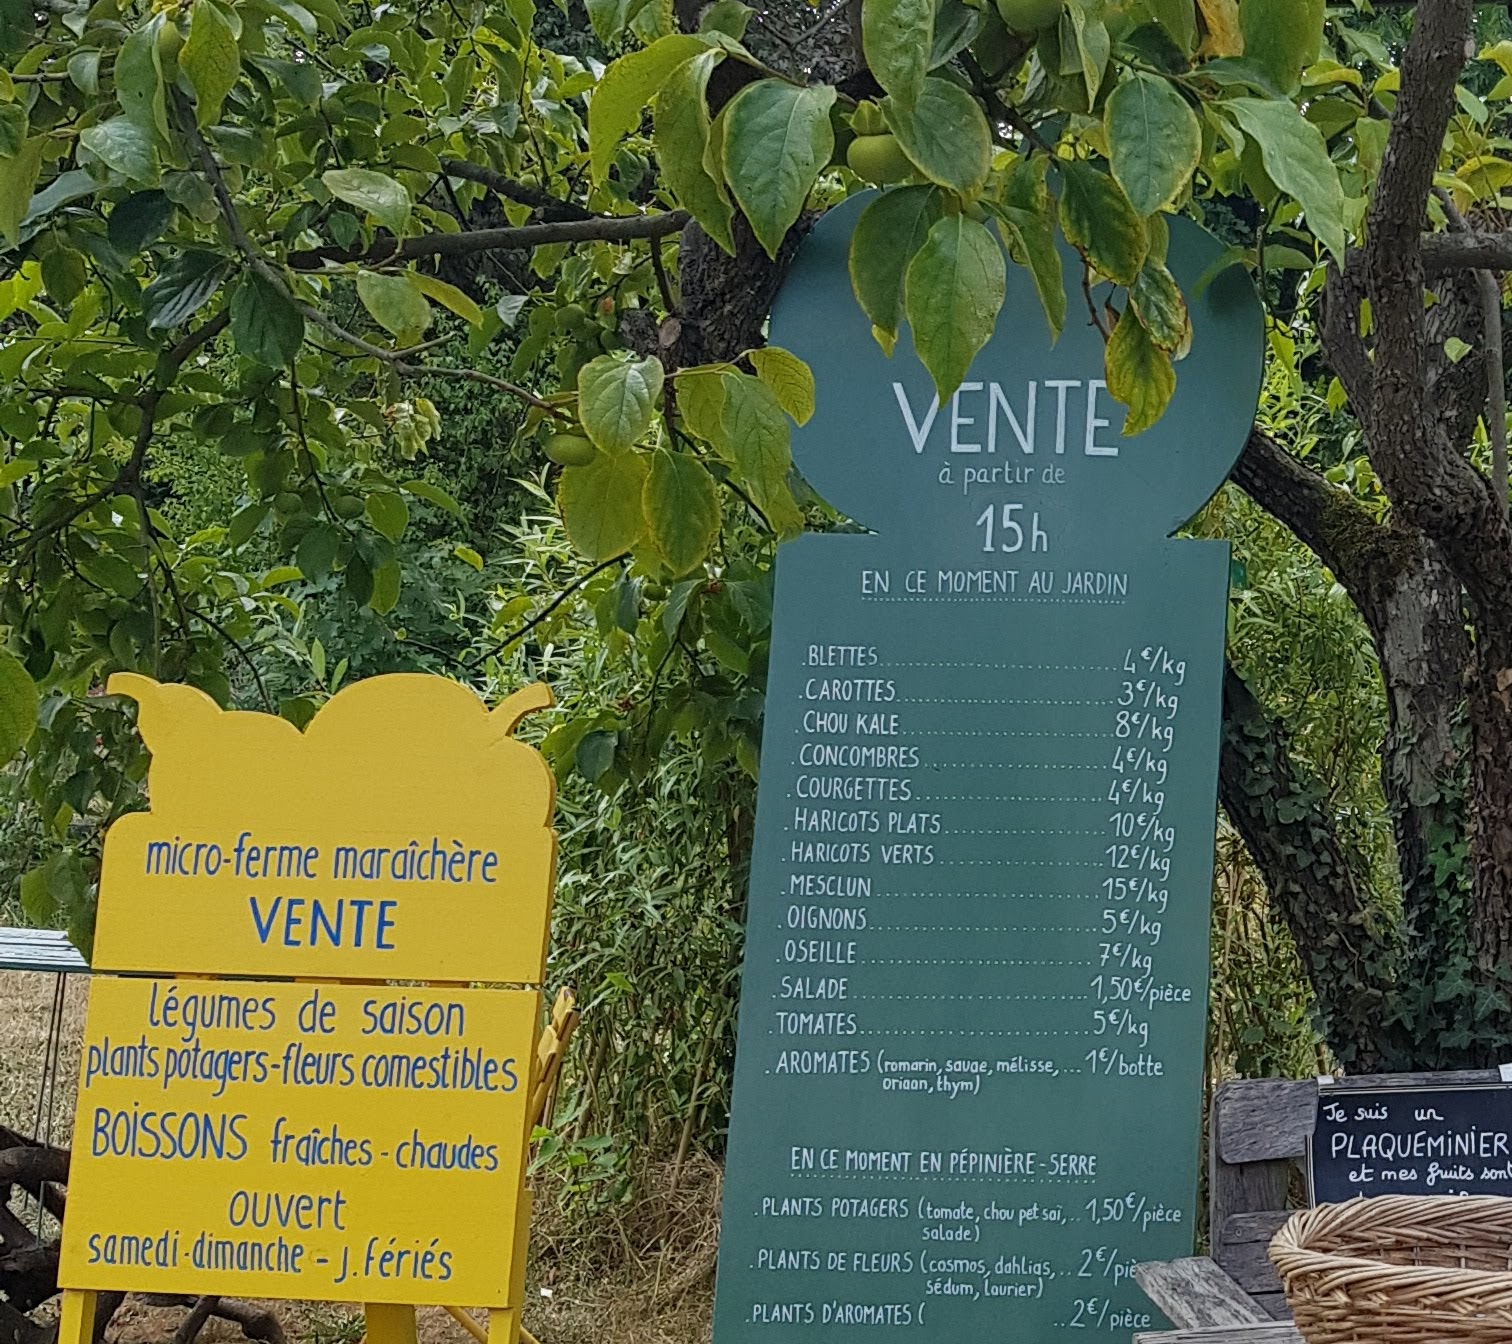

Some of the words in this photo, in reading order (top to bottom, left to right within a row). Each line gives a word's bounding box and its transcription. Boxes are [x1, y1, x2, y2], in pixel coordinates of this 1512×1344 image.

[892, 378, 1119, 458] VENTE
[938, 460, 955, 484] à
[963, 460, 1035, 496] partir
[1041, 462, 1066, 484] de
[861, 570, 890, 594] EN
[905, 570, 927, 593] CE
[938, 570, 1020, 594] MOMENT
[1028, 570, 1054, 594] AU
[1061, 571, 1128, 596] JARDIN
[808, 644, 878, 667] BLETTES
[805, 678, 896, 702] CAROTTES
[803, 709, 848, 734] CHOU
[856, 713, 899, 735] KALE
[799, 742, 920, 768] CONCOMBRES
[796, 774, 912, 801] COURGETTES
[794, 806, 880, 833] HARICOTS
[888, 811, 941, 834] PLATS
[146, 831, 319, 879] micro-ferme
[333, 836, 498, 883] maraîchère
[791, 840, 871, 863] HARICOTS
[881, 844, 934, 865] VERTS
[790, 874, 871, 898] MESCLUN
[249, 896, 398, 950] VENTE
[787, 904, 867, 930] OIGNONS
[784, 939, 857, 964] OSEILLE
[780, 975, 848, 1000] SALADE
[149, 980, 278, 1044] légumes
[298, 988, 336, 1034] de
[361, 996, 465, 1037] saison
[775, 1011, 857, 1035] TOMATES
[84, 1037, 160, 1090] plants
[361, 1046, 518, 1092] comestibles
[775, 1050, 871, 1074] AROMATES
[877, 1049, 943, 1076] (romarin,
[936, 1074, 980, 1100] thym)
[1322, 1102, 1348, 1123] Je
[1353, 1102, 1388, 1121] suis
[1414, 1108, 1445, 1122] un
[270, 1116, 373, 1167] fraîches
[395, 1128, 499, 1172] chaudes
[791, 1146, 814, 1170] EN
[819, 1148, 840, 1170] CE
[845, 1149, 913, 1173] MOMENT
[920, 1151, 942, 1173] EN
[1348, 1163, 1375, 1183] et
[1381, 1168, 1418, 1181] mes
[1426, 1161, 1475, 1187] fruits
[228, 1189, 347, 1231] ouvert
[762, 1196, 823, 1217] PLANTS
[831, 1197, 909, 1218] POTAGERS
[917, 1195, 980, 1224] (tomate,
[983, 1200, 1015, 1221] chou
[921, 1223, 980, 1243] salade)
[757, 1248, 821, 1270] PLANTS
[827, 1252, 847, 1271] DE
[853, 1251, 914, 1273] FLEURS
[920, 1249, 992, 1282] (cosmos,
[925, 1277, 980, 1301] sédum,
[984, 1276, 1044, 1299] laurier)
[752, 1302, 815, 1324] PLANTS
[822, 1300, 912, 1325] D'AROMATES
